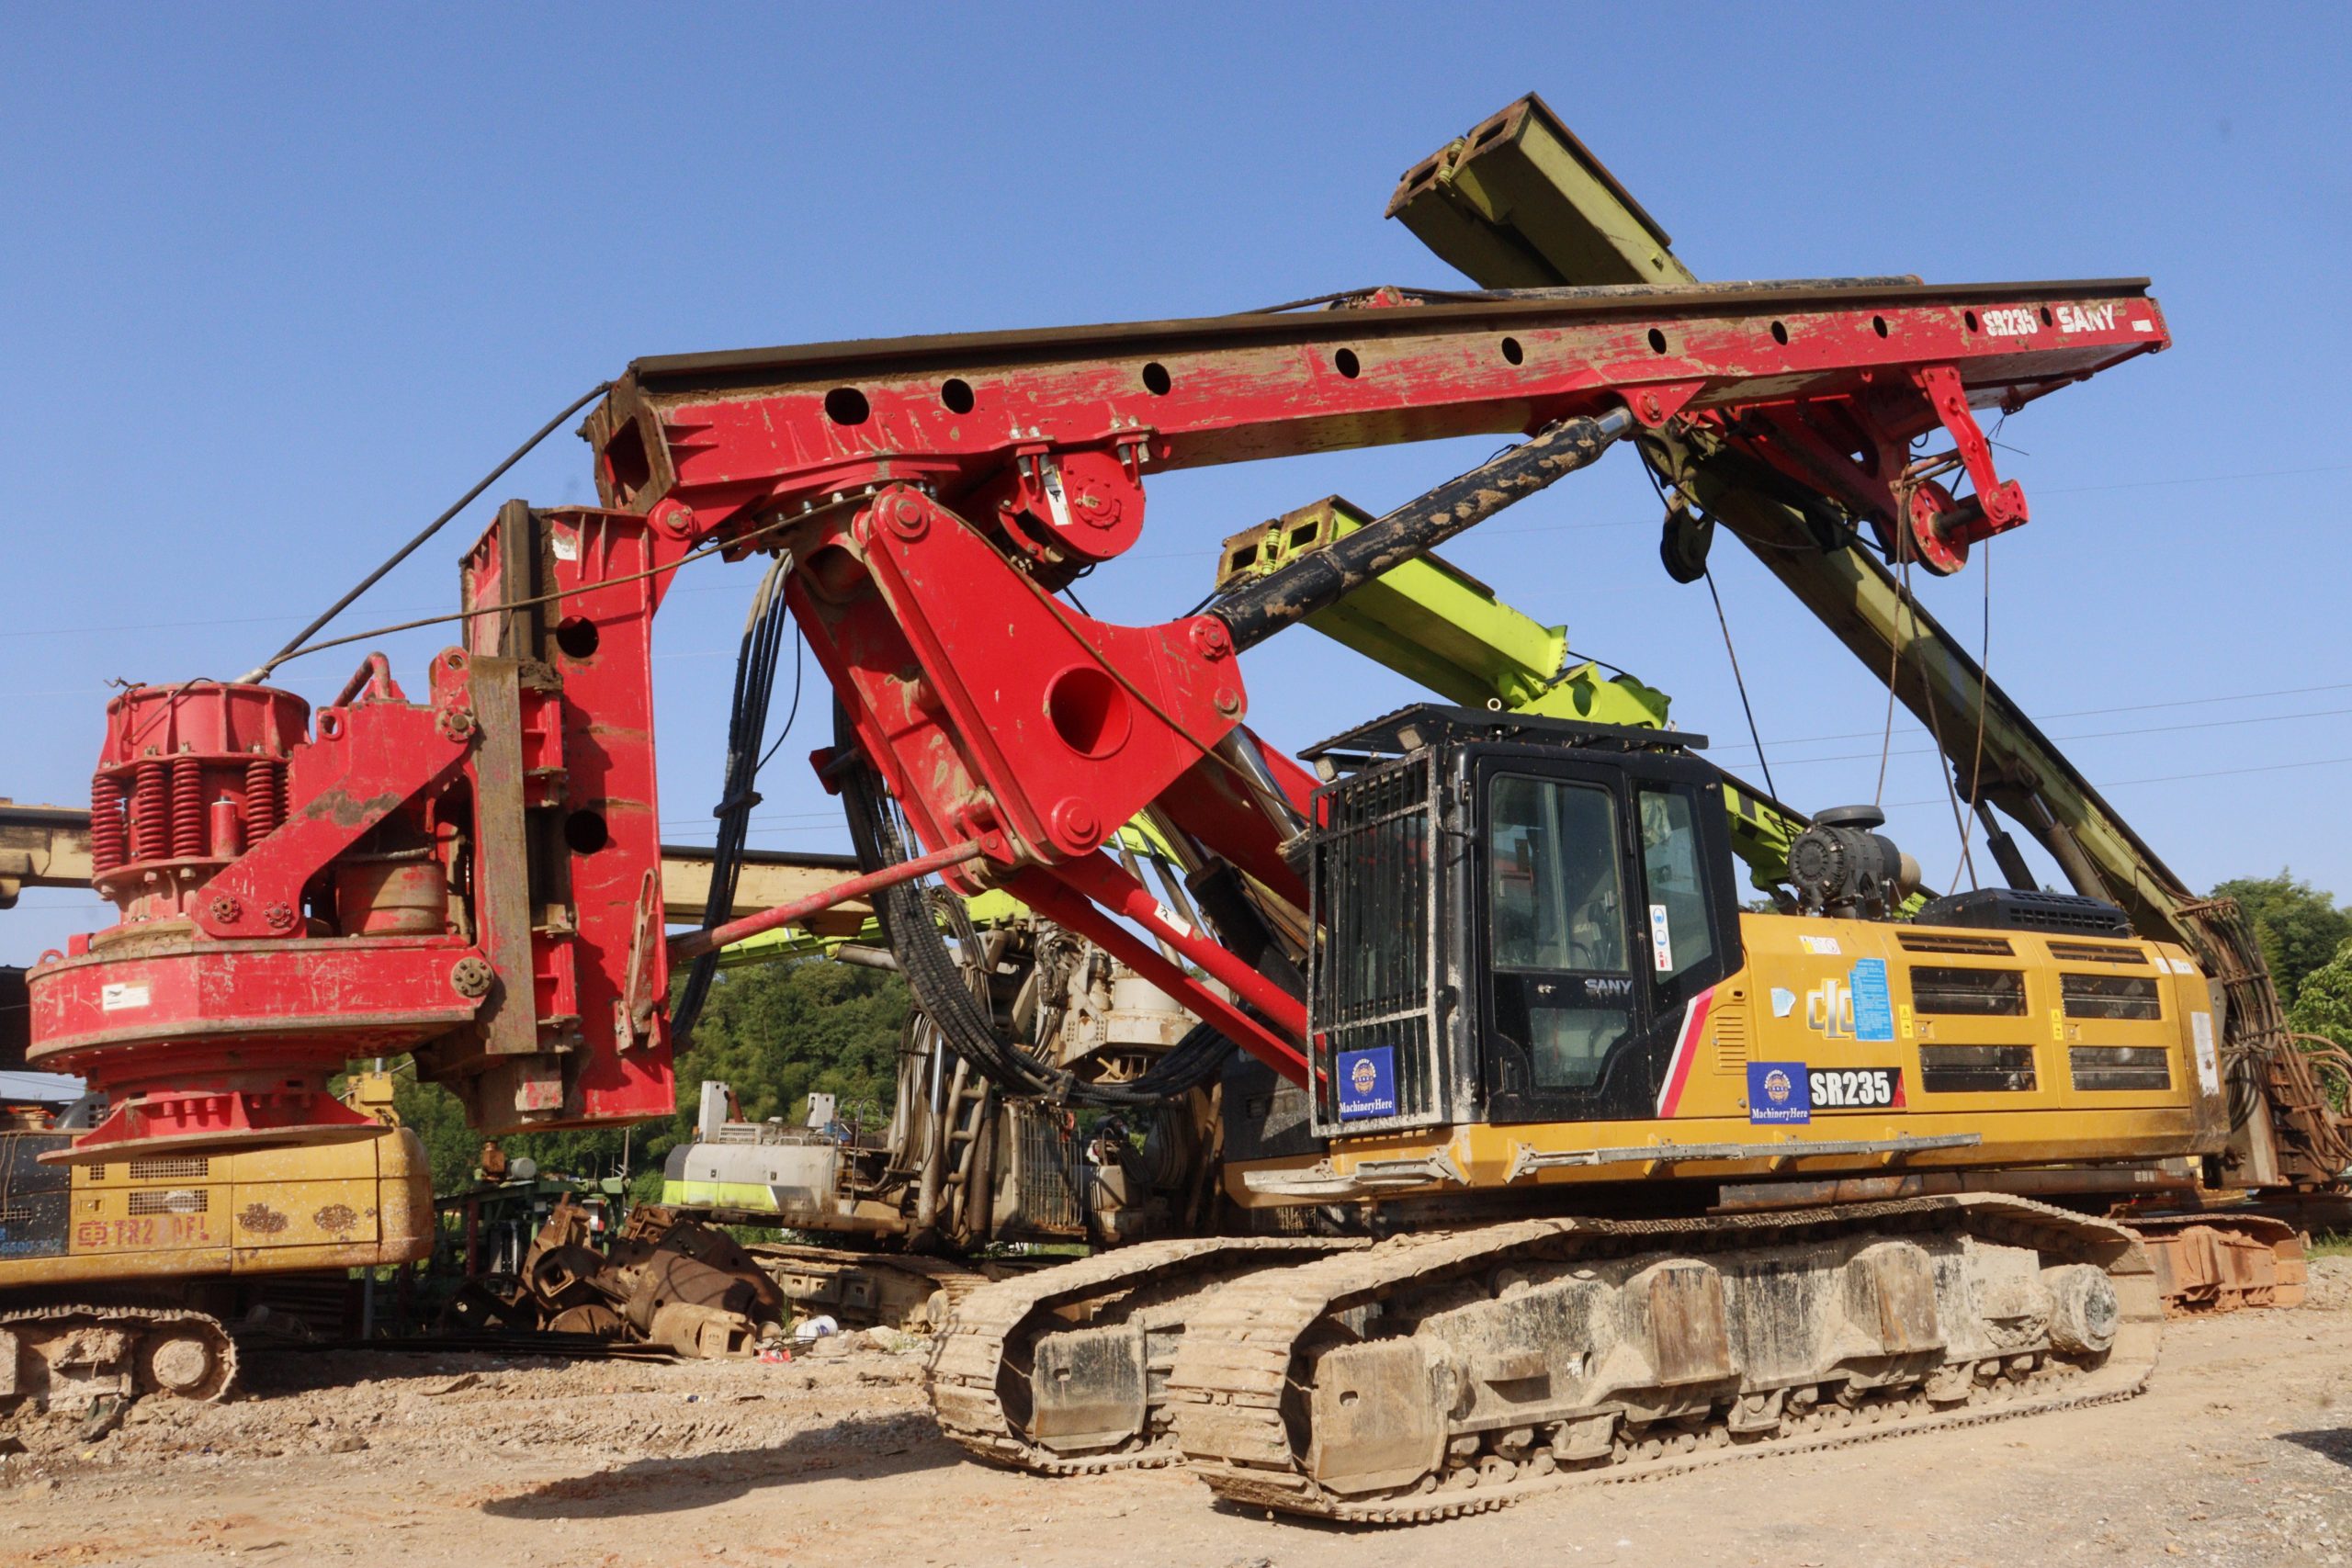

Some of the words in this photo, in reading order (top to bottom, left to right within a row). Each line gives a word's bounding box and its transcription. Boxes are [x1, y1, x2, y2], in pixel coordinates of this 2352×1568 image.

[1983, 309, 2039, 336] SR235
[2056, 304, 2116, 333] SANY
[1585, 978, 1633, 995] SANY
[1810, 1071, 1891, 1106] SR235
[1340, 1099, 1393, 1113] MachineryHere
[1752, 1108, 1808, 1121] MachineryHere
